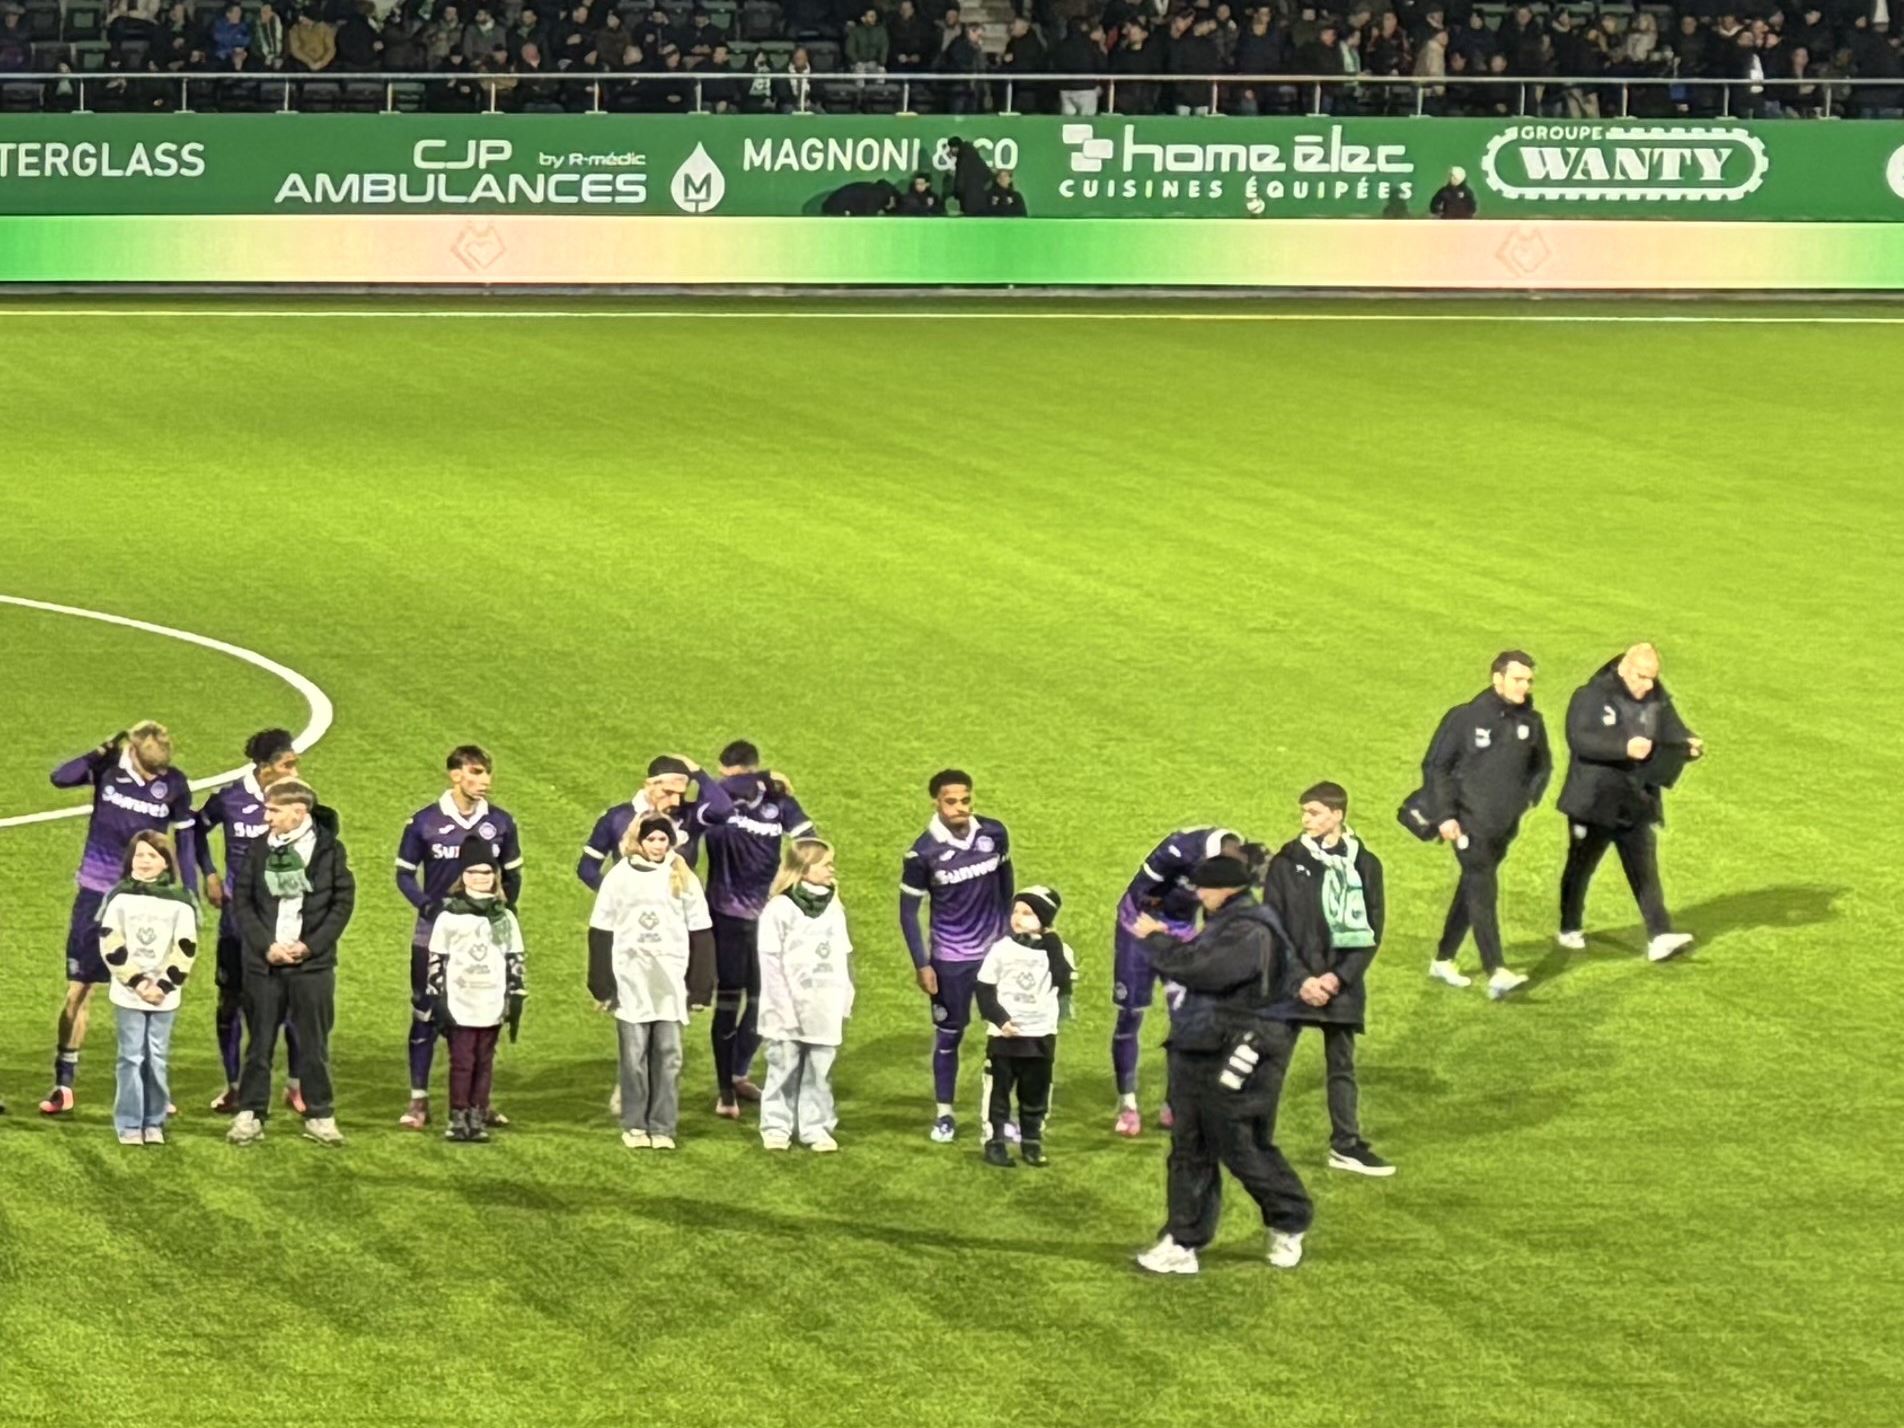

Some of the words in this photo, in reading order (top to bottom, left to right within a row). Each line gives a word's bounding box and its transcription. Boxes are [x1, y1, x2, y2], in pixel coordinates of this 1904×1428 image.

[1123, 124, 1286, 173] home
[1520, 125, 1603, 141] GROUPE
[413, 139, 513, 169] CJP
[539, 151, 564, 168] by
[743, 138, 921, 172] MAGNONI
[1520, 147, 1733, 181] WANTY
[274, 173, 647, 204] AMBULANCES
[1059, 179, 1224, 199] CUISINES
[1245, 175, 1413, 200] ÉQUIPÉES
